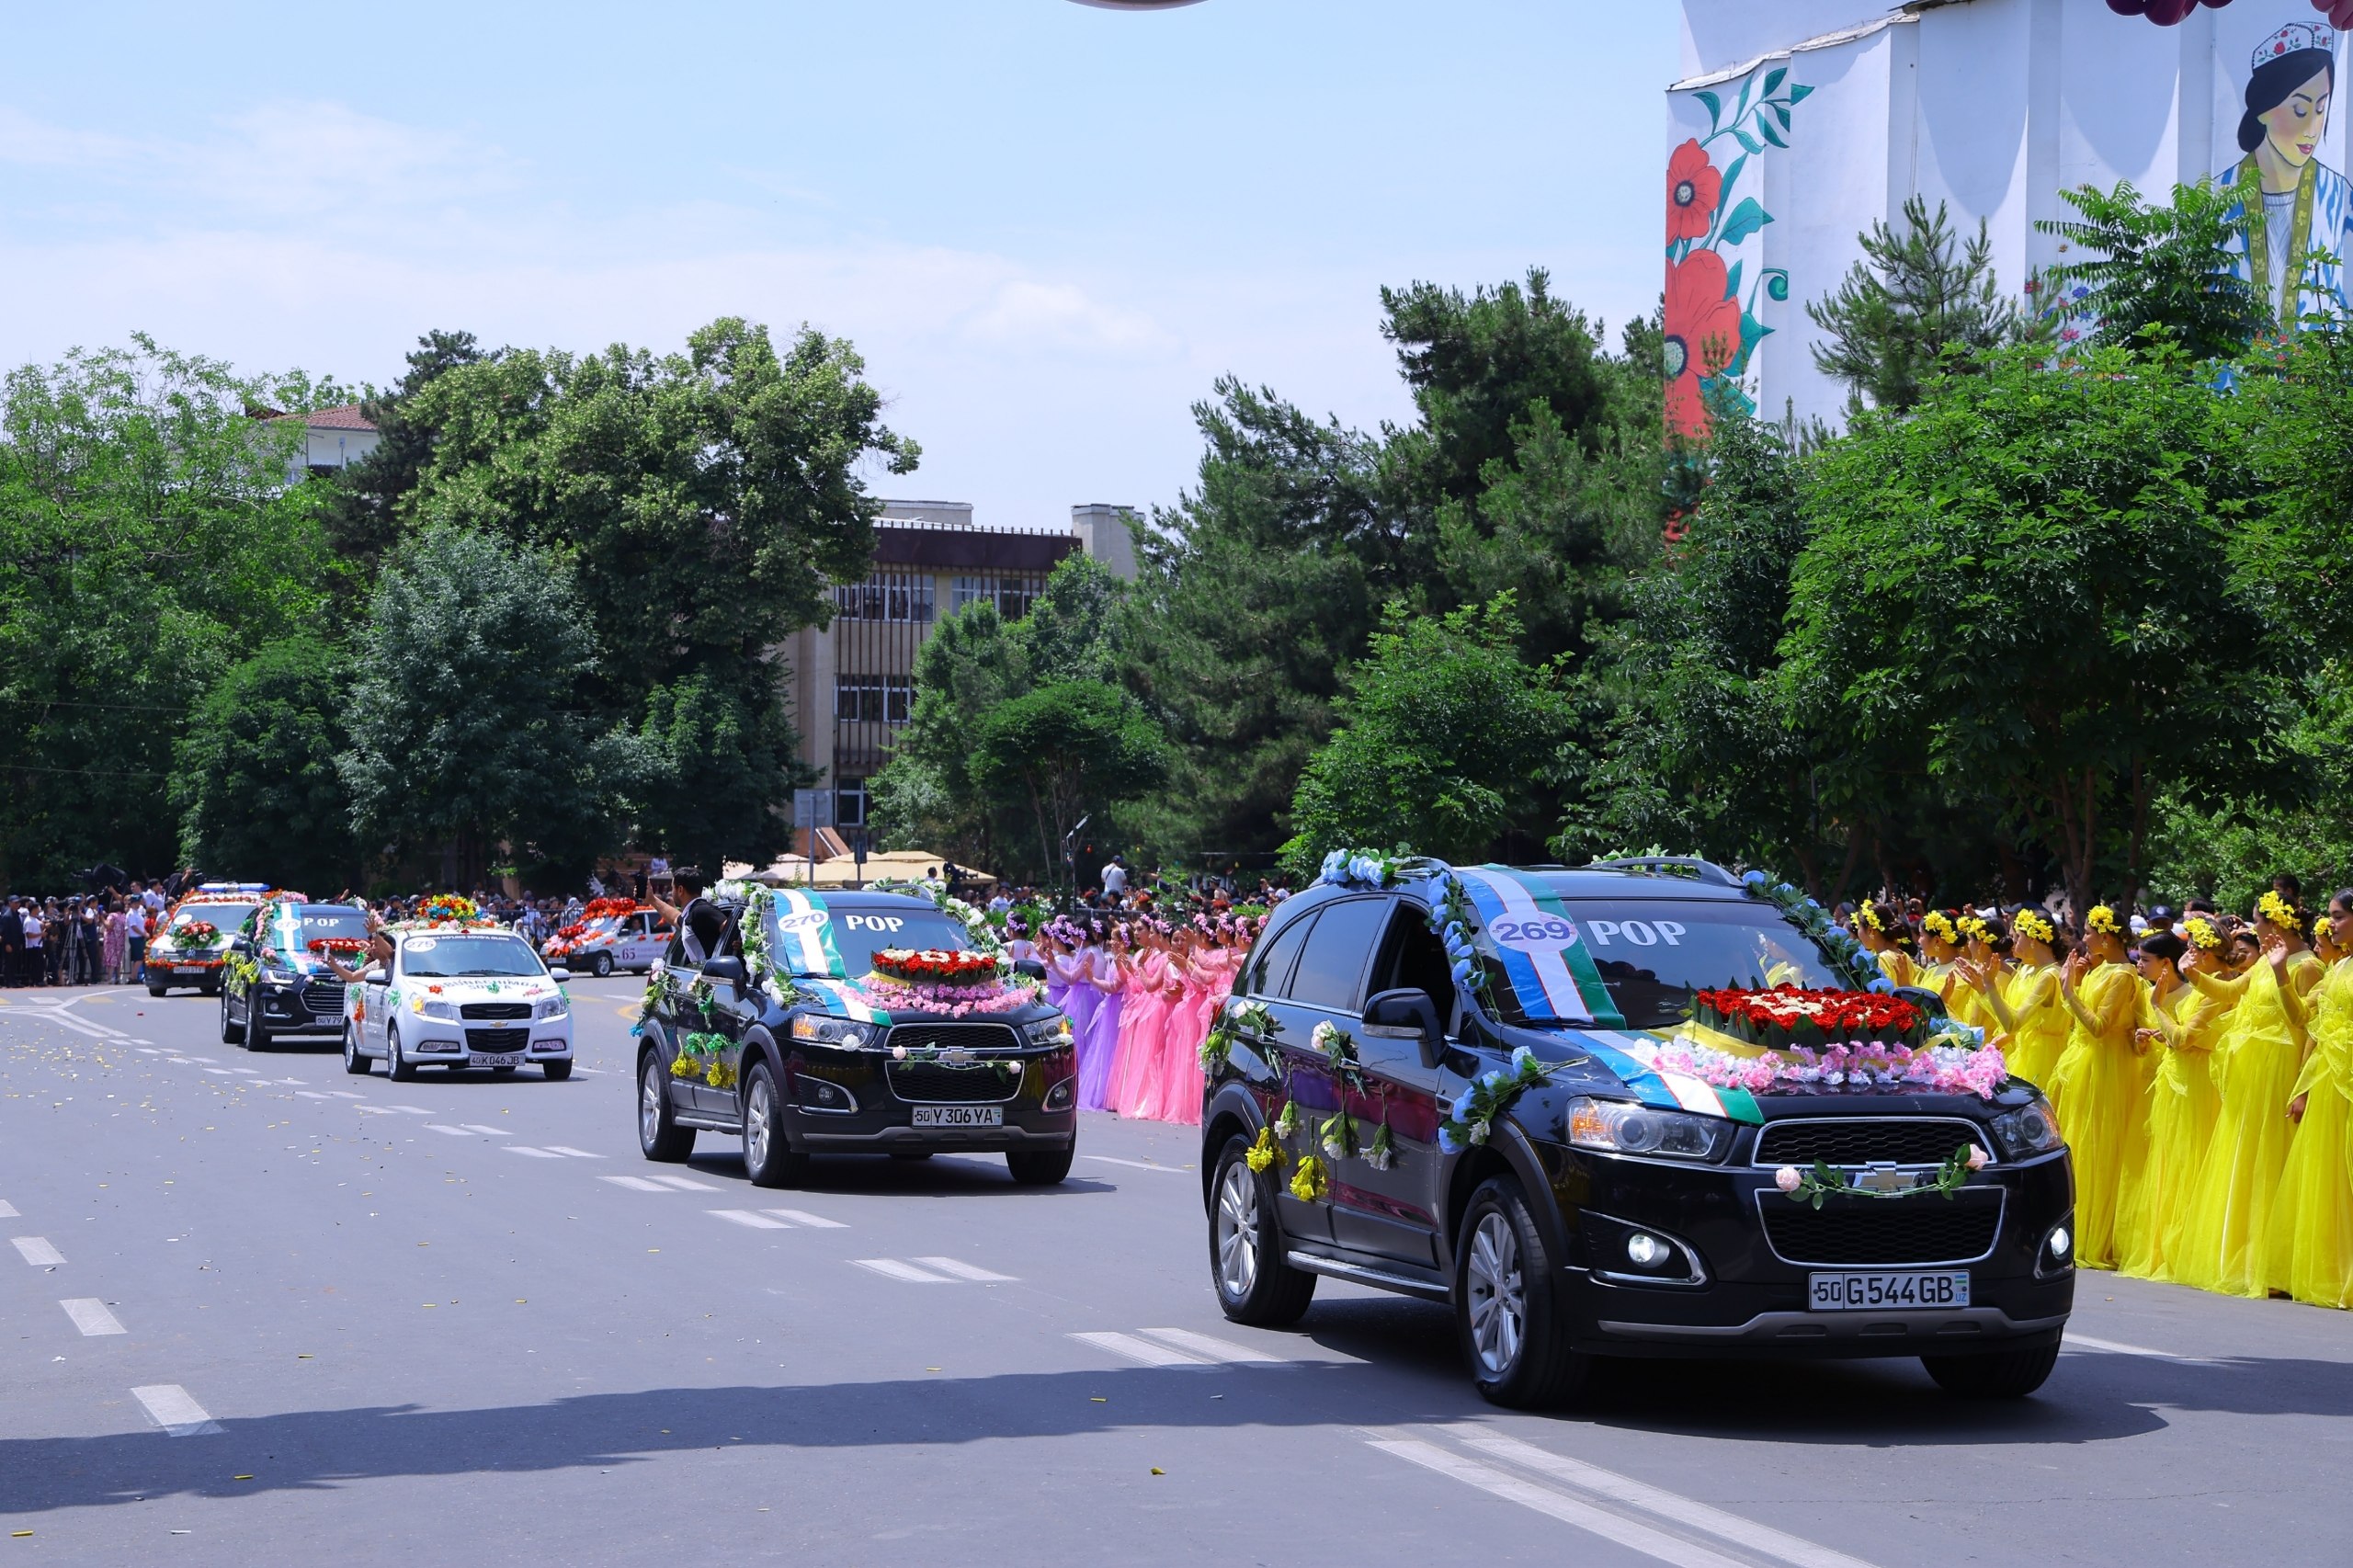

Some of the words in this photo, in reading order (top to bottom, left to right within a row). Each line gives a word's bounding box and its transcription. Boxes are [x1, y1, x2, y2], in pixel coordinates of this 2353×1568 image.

[303, 917, 339, 927] POP
[782, 913, 825, 929] 270
[845, 915, 904, 933] POP
[1495, 921, 1571, 942] 269
[1586, 920, 1687, 946] POP
[406, 940, 434, 949] 275
[622, 948, 636, 960] 65
[916, 1110, 930, 1122] 50
[1817, 1281, 1842, 1302] 50
[1955, 1293, 1967, 1302] UZ
